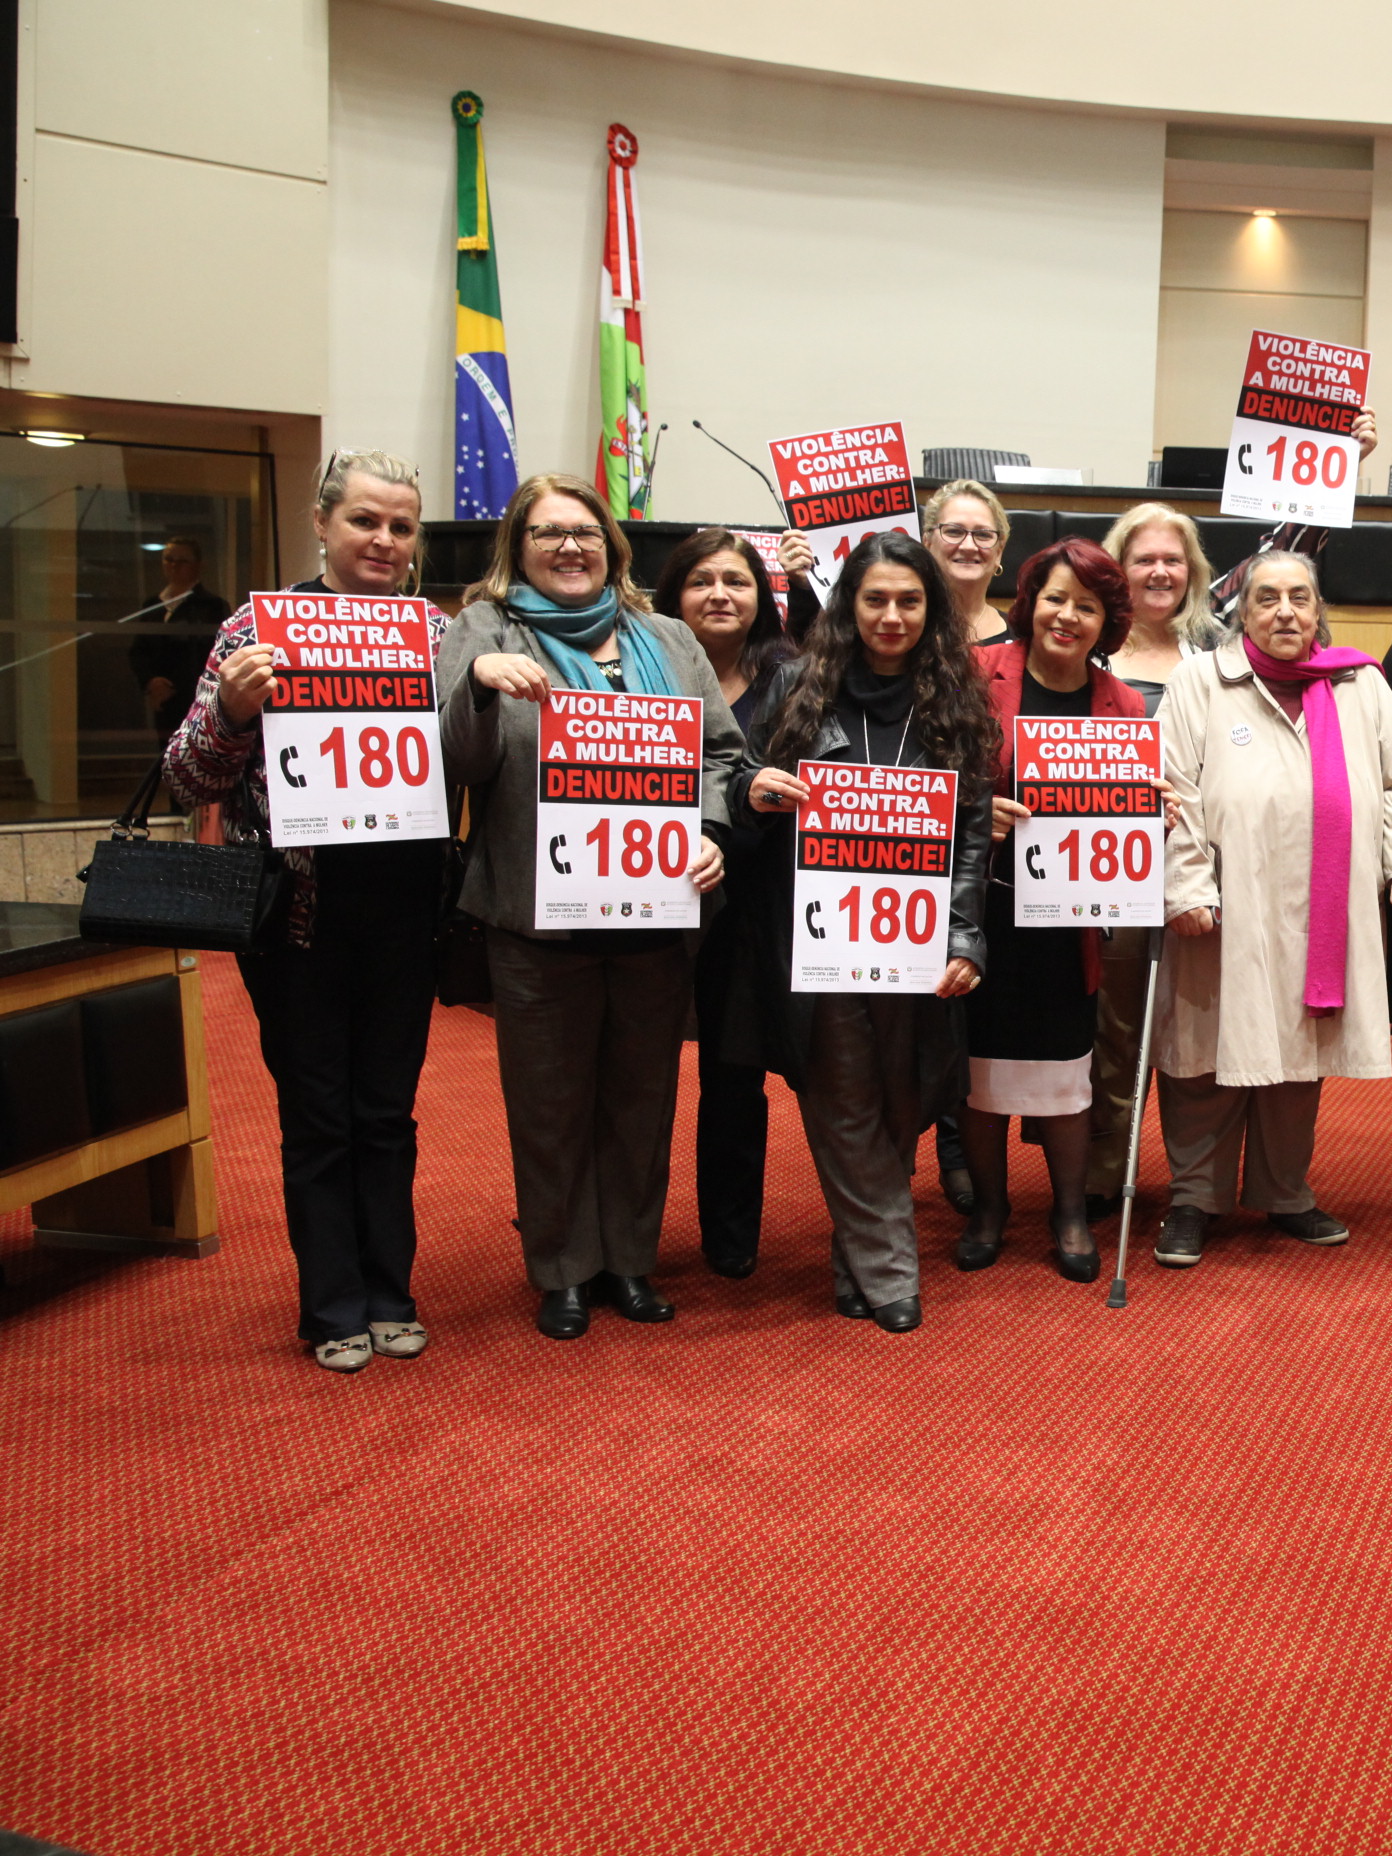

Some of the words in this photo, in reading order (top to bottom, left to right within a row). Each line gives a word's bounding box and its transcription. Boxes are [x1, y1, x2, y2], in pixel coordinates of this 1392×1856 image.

[1258, 335, 1364, 370] VIOLÊNCIA
[462, 358, 496, 402] ORDEM
[1267, 357, 1351, 385] CONTRA
[1249, 372, 1263, 387] A
[1270, 376, 1361, 405] MULHER:
[776, 427, 898, 459] VIOLÊNCIA
[797, 448, 889, 475] CONTRA
[1267, 436, 1348, 489] 180
[789, 480, 805, 497] A
[809, 465, 905, 492] MULHER:
[792, 486, 911, 527] DENUNCIE!
[262, 598, 419, 623] VIOLÊNCIA
[286, 624, 405, 645] CONTRA
[271, 647, 291, 666] A
[301, 649, 425, 668] MULHER:
[272, 676, 428, 707] DENUNCIE!
[550, 696, 694, 721] VIOLÊNCIA
[566, 720, 677, 742] CONTRA
[1023, 720, 1153, 741] VIOLÊNCIA
[320, 726, 429, 788] 180
[548, 742, 567, 759] A
[576, 743, 694, 765] MULHER:
[1039, 743, 1139, 760] CONTRA
[547, 769, 694, 801] DENUNCIE!
[806, 767, 948, 793] VIOLÊNCIA
[1023, 763, 1040, 779] A
[1049, 763, 1155, 780] MULHER:
[823, 792, 930, 814] CONTRA
[1023, 787, 1157, 813] DENUNCIE!
[805, 812, 822, 829] A
[831, 813, 946, 836] MULHER:
[586, 818, 689, 878] 180
[804, 837, 945, 871] DENUNCIE!
[1058, 829, 1152, 882] 180
[839, 886, 936, 945] 180
